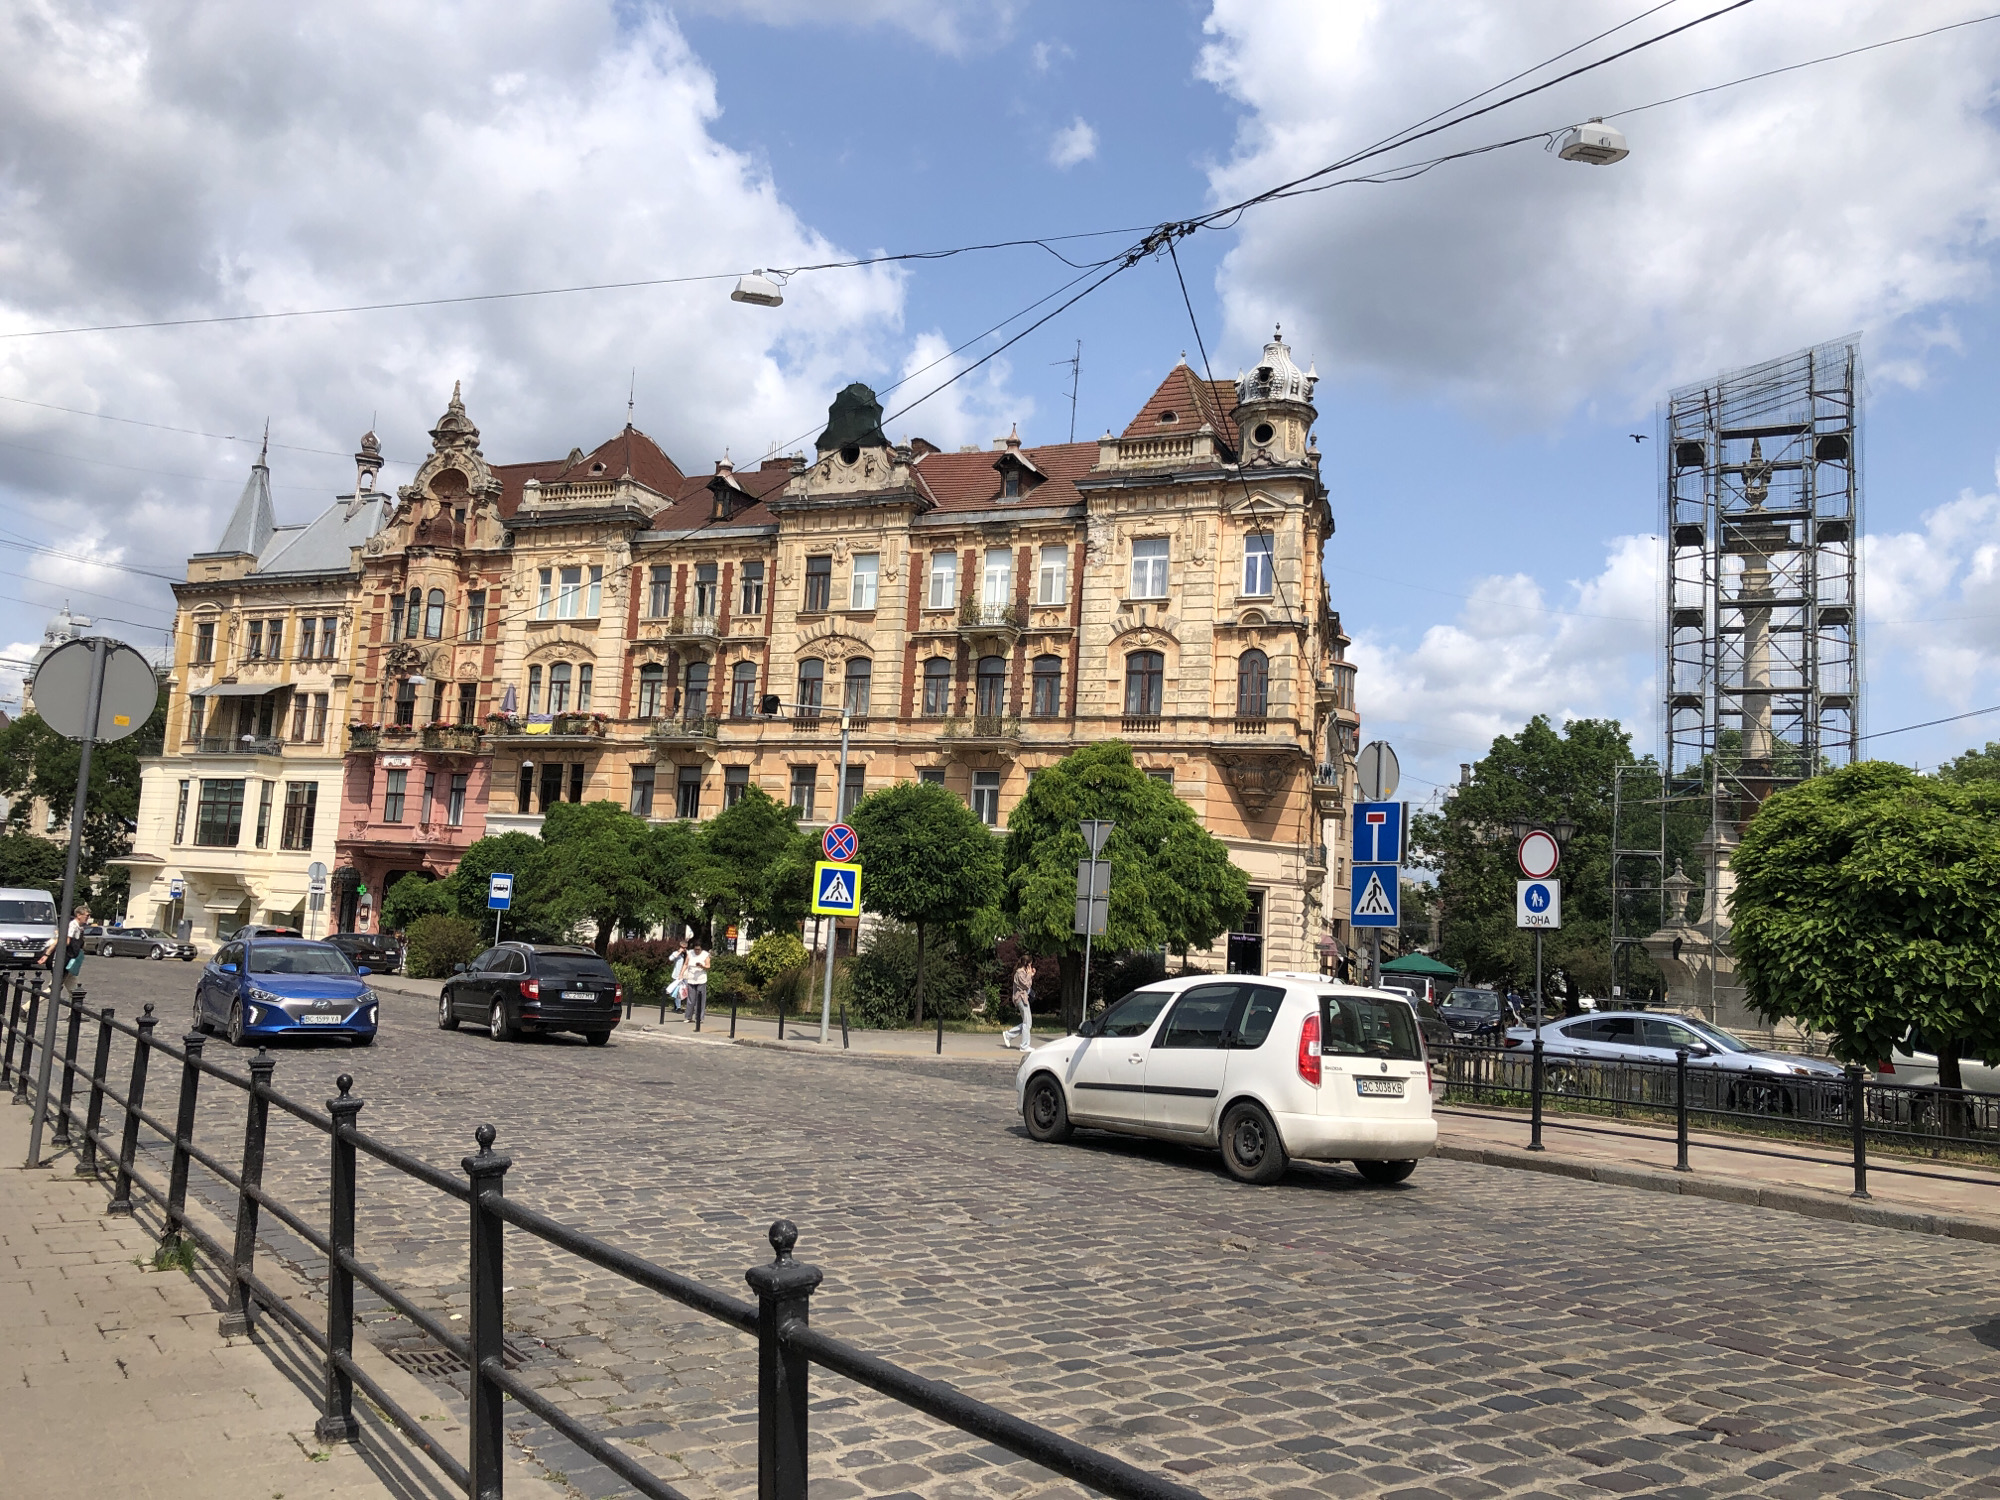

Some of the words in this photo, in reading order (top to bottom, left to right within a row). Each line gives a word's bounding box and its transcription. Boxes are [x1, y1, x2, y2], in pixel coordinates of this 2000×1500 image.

[1525, 915, 1550, 925] ЗОНА
[1362, 1081, 1374, 1092] BC
[1375, 1082, 1392, 1093] 3038
[1392, 1083, 1403, 1093] KB
